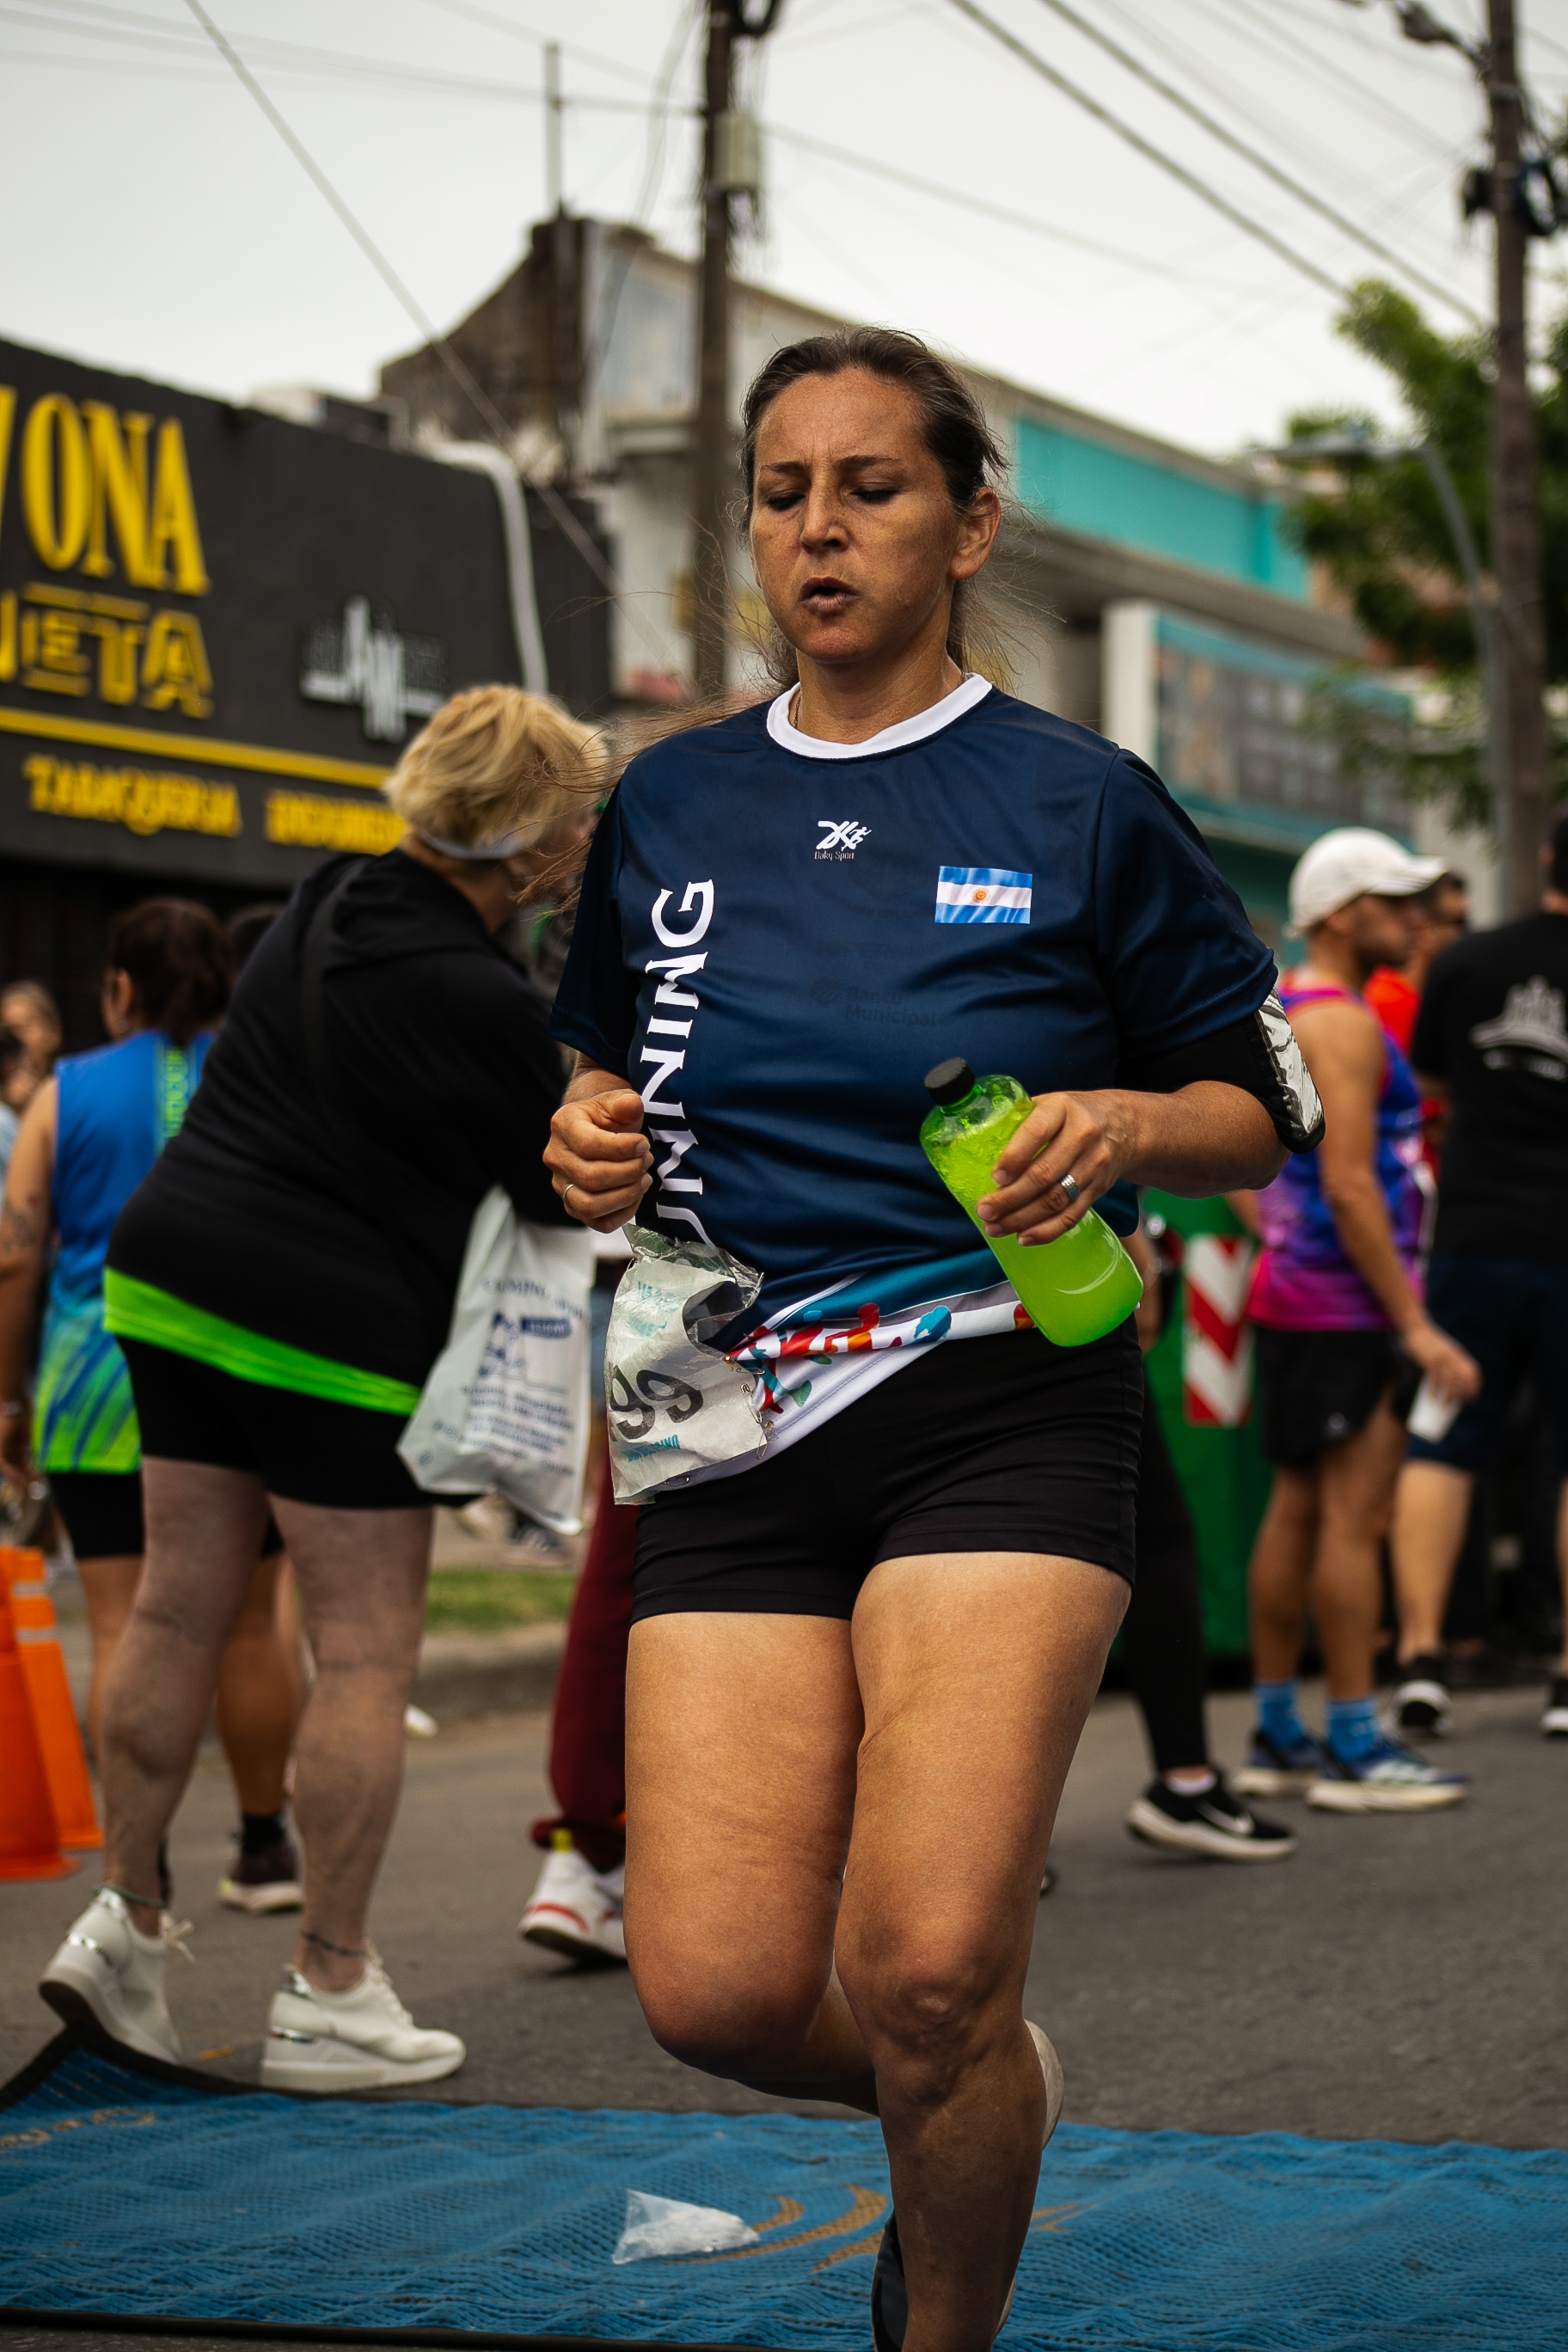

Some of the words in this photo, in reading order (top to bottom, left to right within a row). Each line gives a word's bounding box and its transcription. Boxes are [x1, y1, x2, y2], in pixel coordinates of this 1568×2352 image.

[814, 850, 833, 861] Daky
[835, 850, 854, 861] Sport
[640, 879, 714, 1258] UNNING
[609, 1364, 704, 1442] 99
